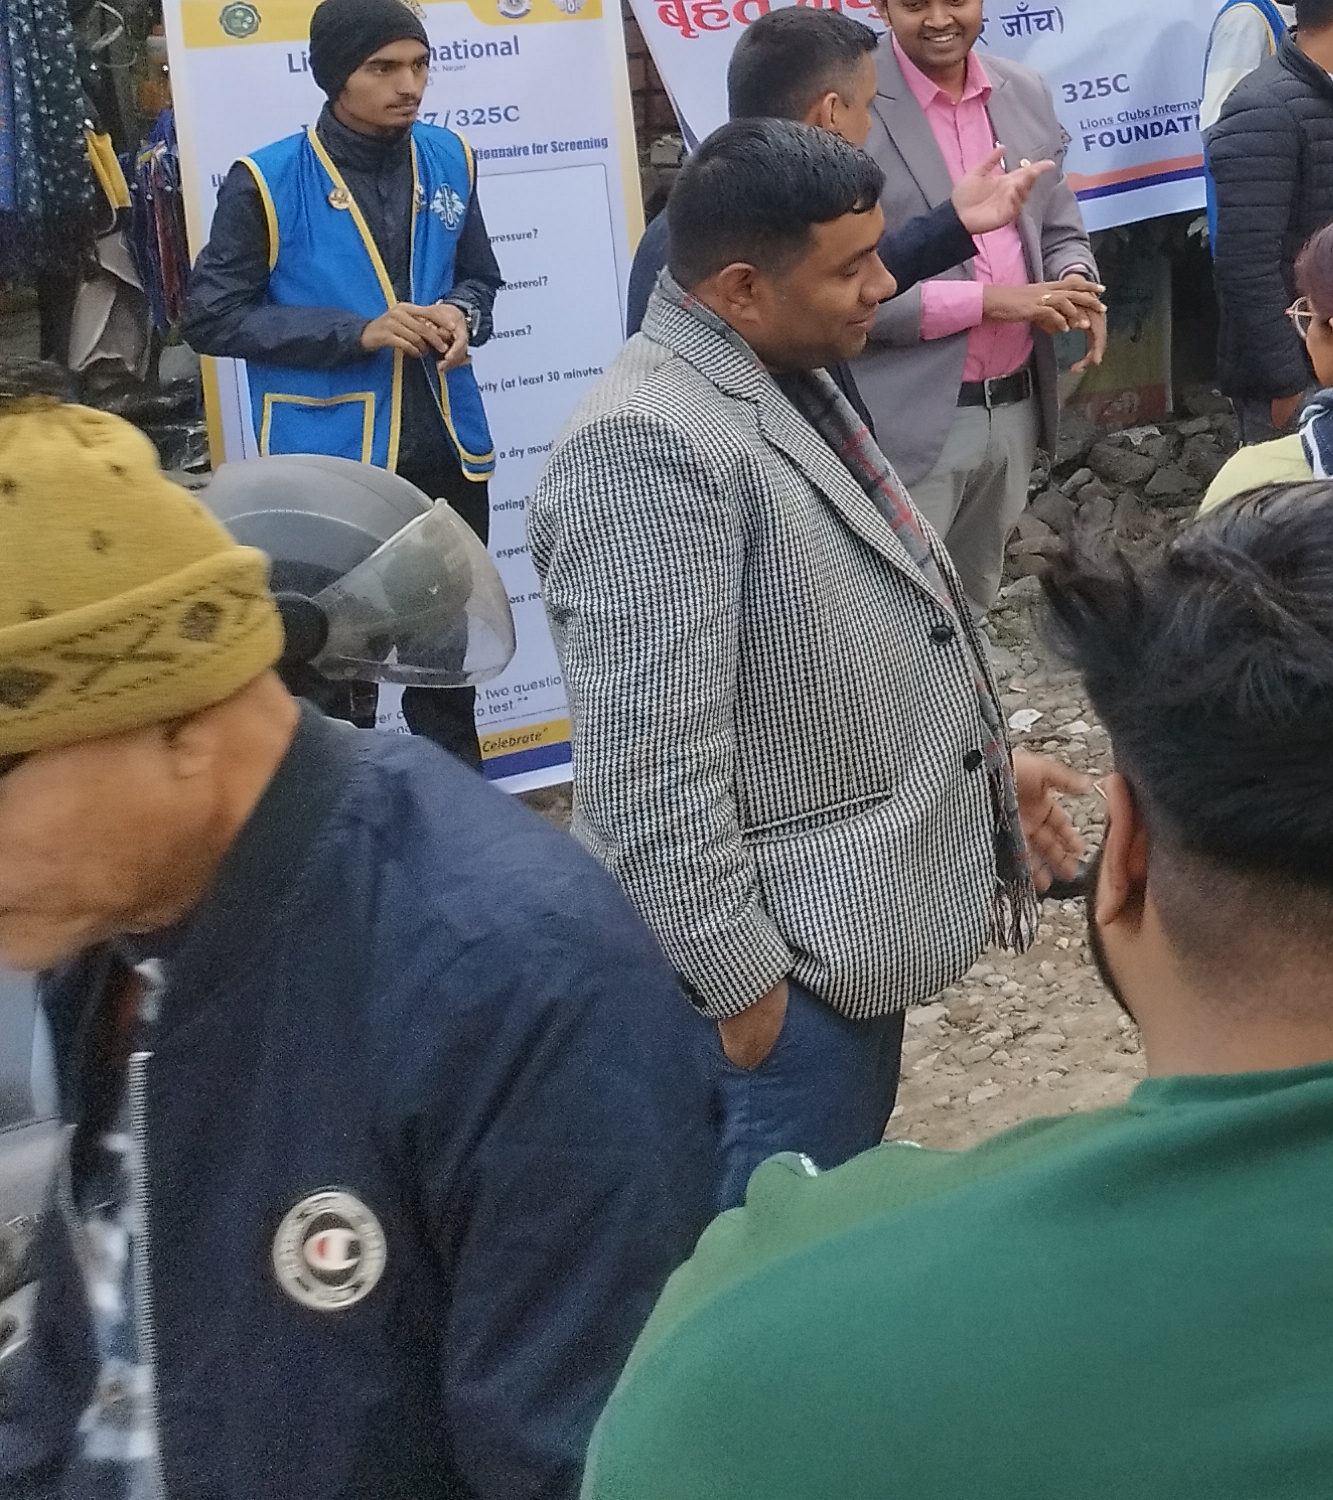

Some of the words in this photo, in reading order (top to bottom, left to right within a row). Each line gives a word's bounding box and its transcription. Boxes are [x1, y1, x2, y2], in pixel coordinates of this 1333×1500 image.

[999, 1, 1065, 39] जाँच)
[1061, 74, 1131, 104] 325C
[1079, 116, 1114, 131] Lions
[1116, 108, 1151, 124] Clubs
[1152, 98, 1201, 117] Interna
[1083, 114, 1201, 151] FOUNDATI
[532, 141, 549, 158] for
[550, 135, 609, 155] Screening
[518, 374, 544, 387] least
[547, 370, 560, 382] 30
[562, 365, 604, 379] minutes
[508, 444, 525, 459] dry
[485, 688, 510, 700] two
[513, 675, 562, 698] questio
